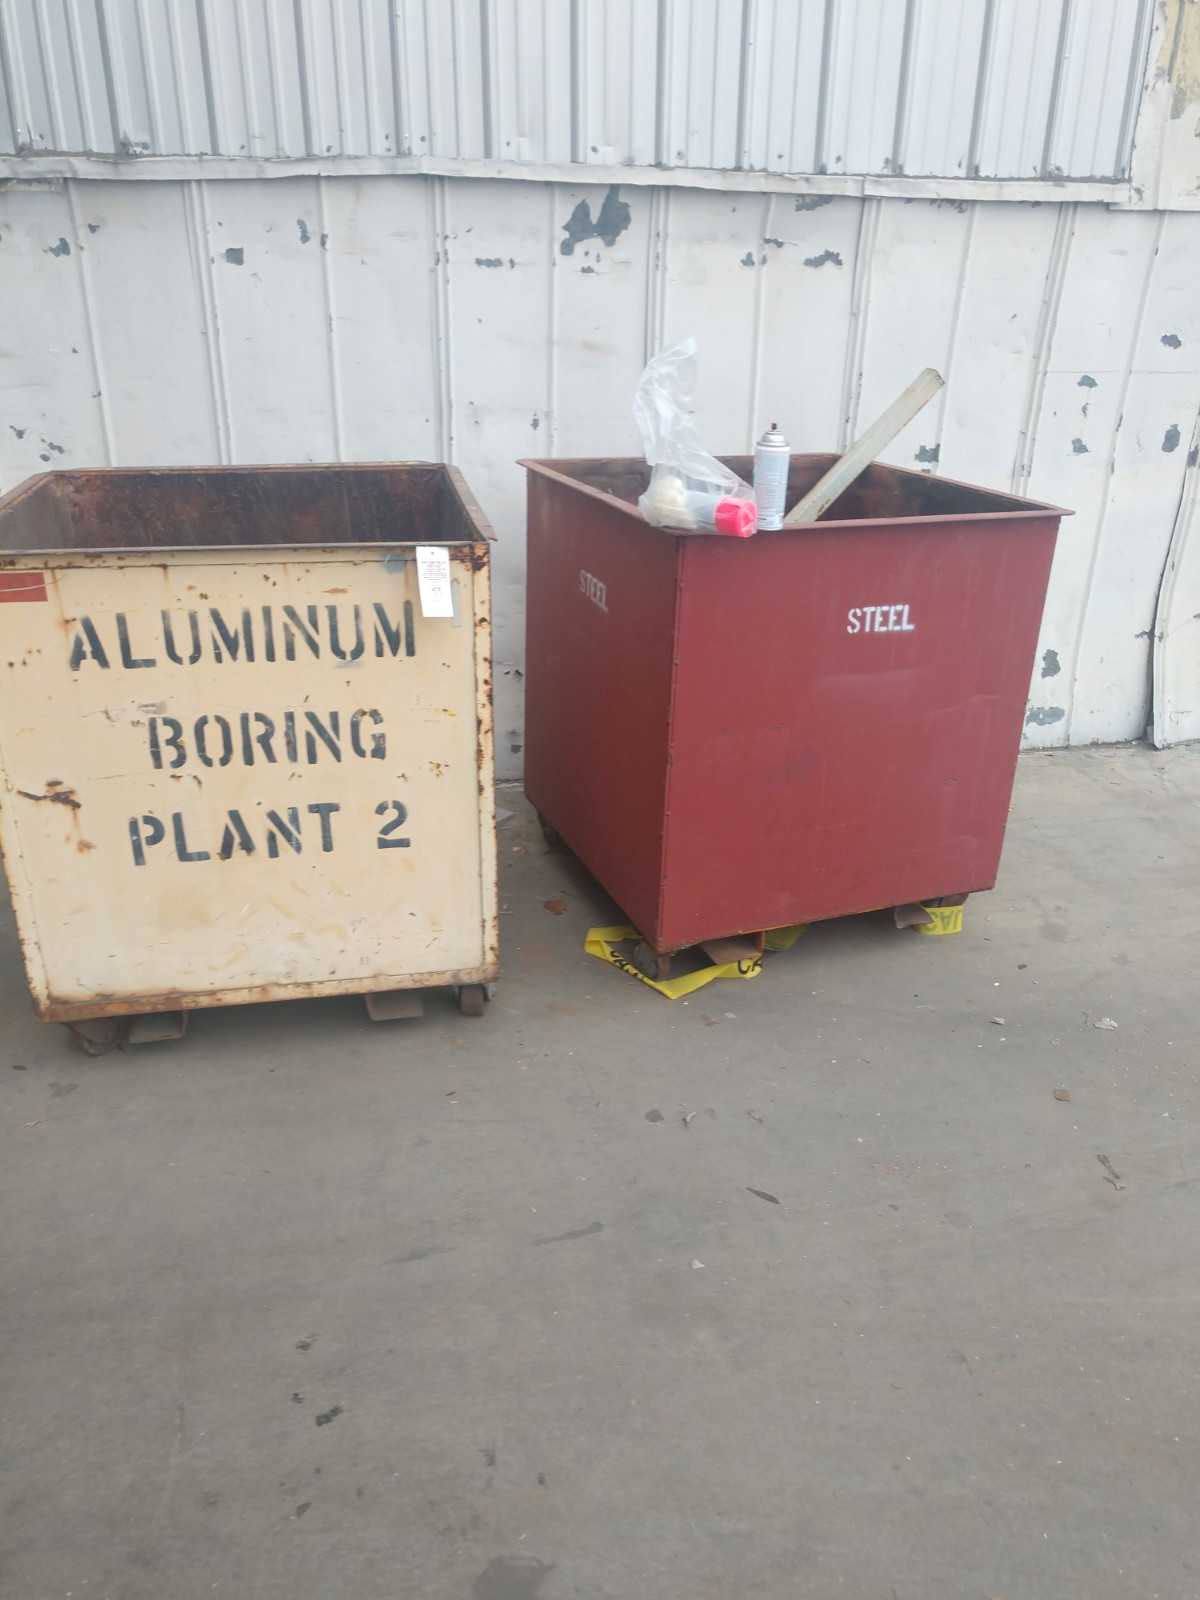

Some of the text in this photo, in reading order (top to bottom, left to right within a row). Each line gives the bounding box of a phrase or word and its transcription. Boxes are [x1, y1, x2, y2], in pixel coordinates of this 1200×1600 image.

[579, 569, 609, 612] STEEL
[847, 604, 915, 634] STEEL
[69, 600, 416, 671] ALUMINUM
[148, 708, 387, 769] BORING
[128, 800, 411, 867] PLANT 2
